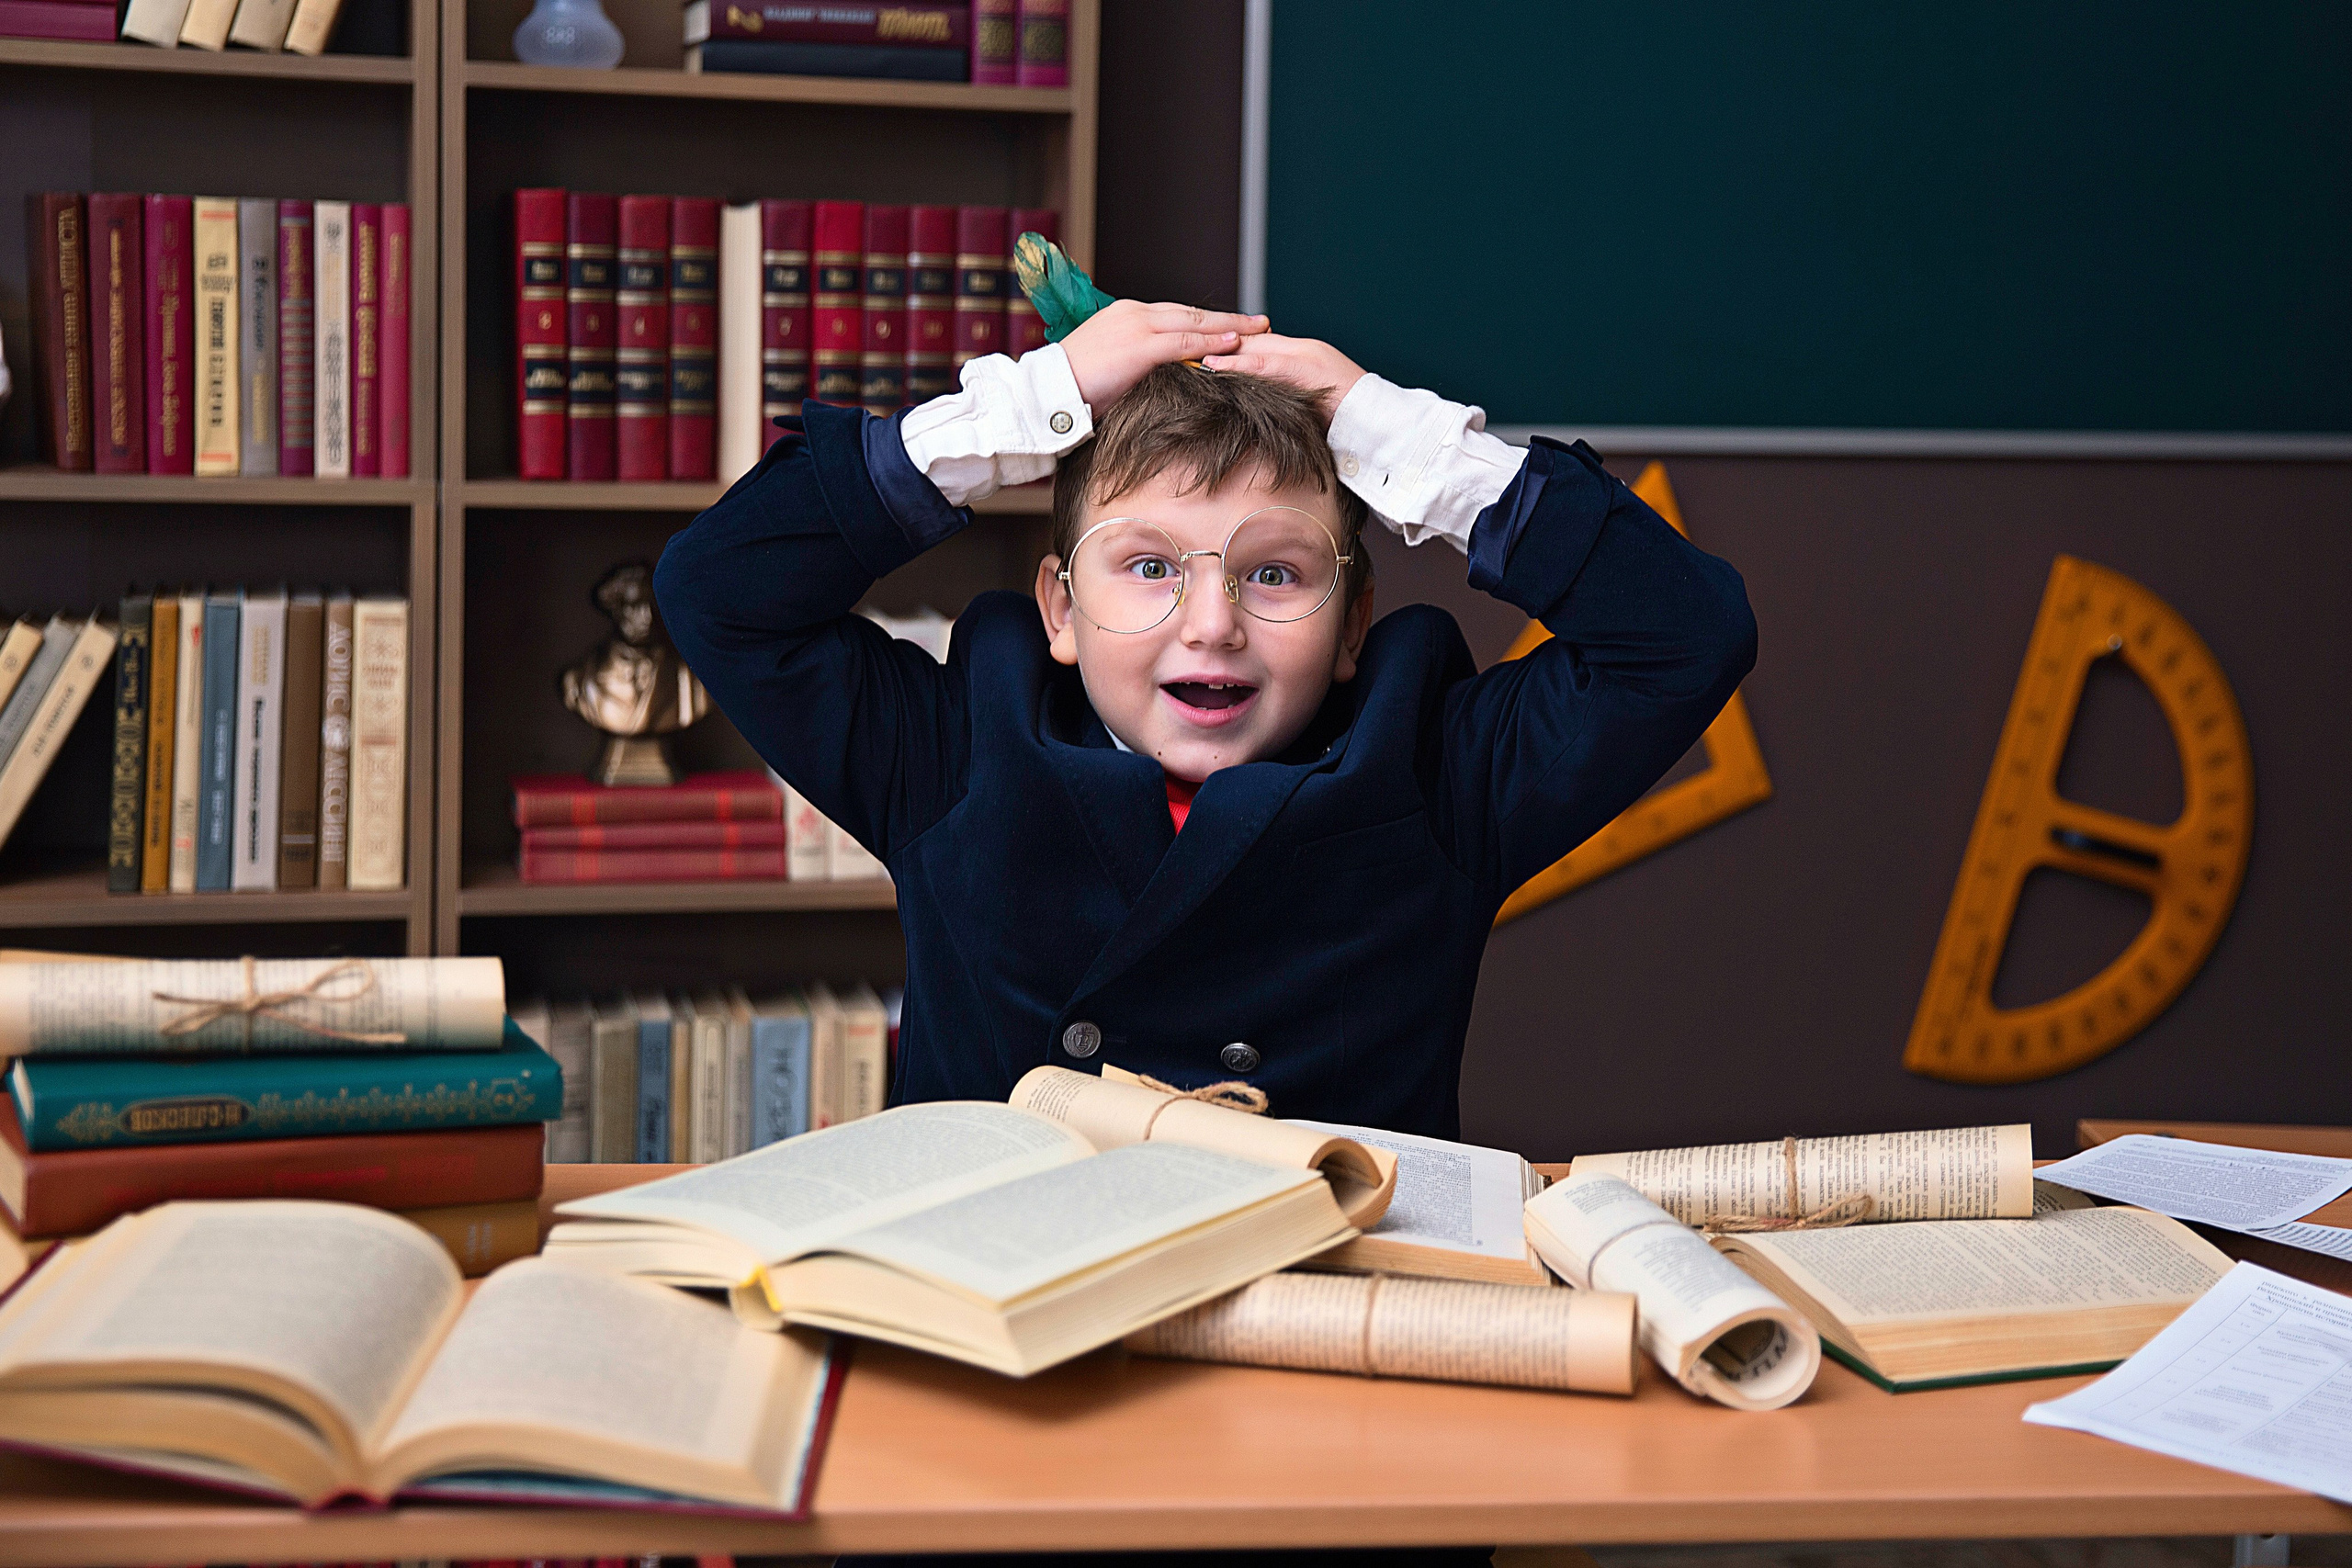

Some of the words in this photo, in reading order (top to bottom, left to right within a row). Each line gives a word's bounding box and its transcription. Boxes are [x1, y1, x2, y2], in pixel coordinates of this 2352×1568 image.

[1880, 1156, 1886, 1164] бы
[1679, 1177, 1683, 1188] мы
[1975, 1171, 1983, 1183] Ты
[1687, 1201, 1691, 1209] от
[2315, 1314, 2349, 1328] истории
